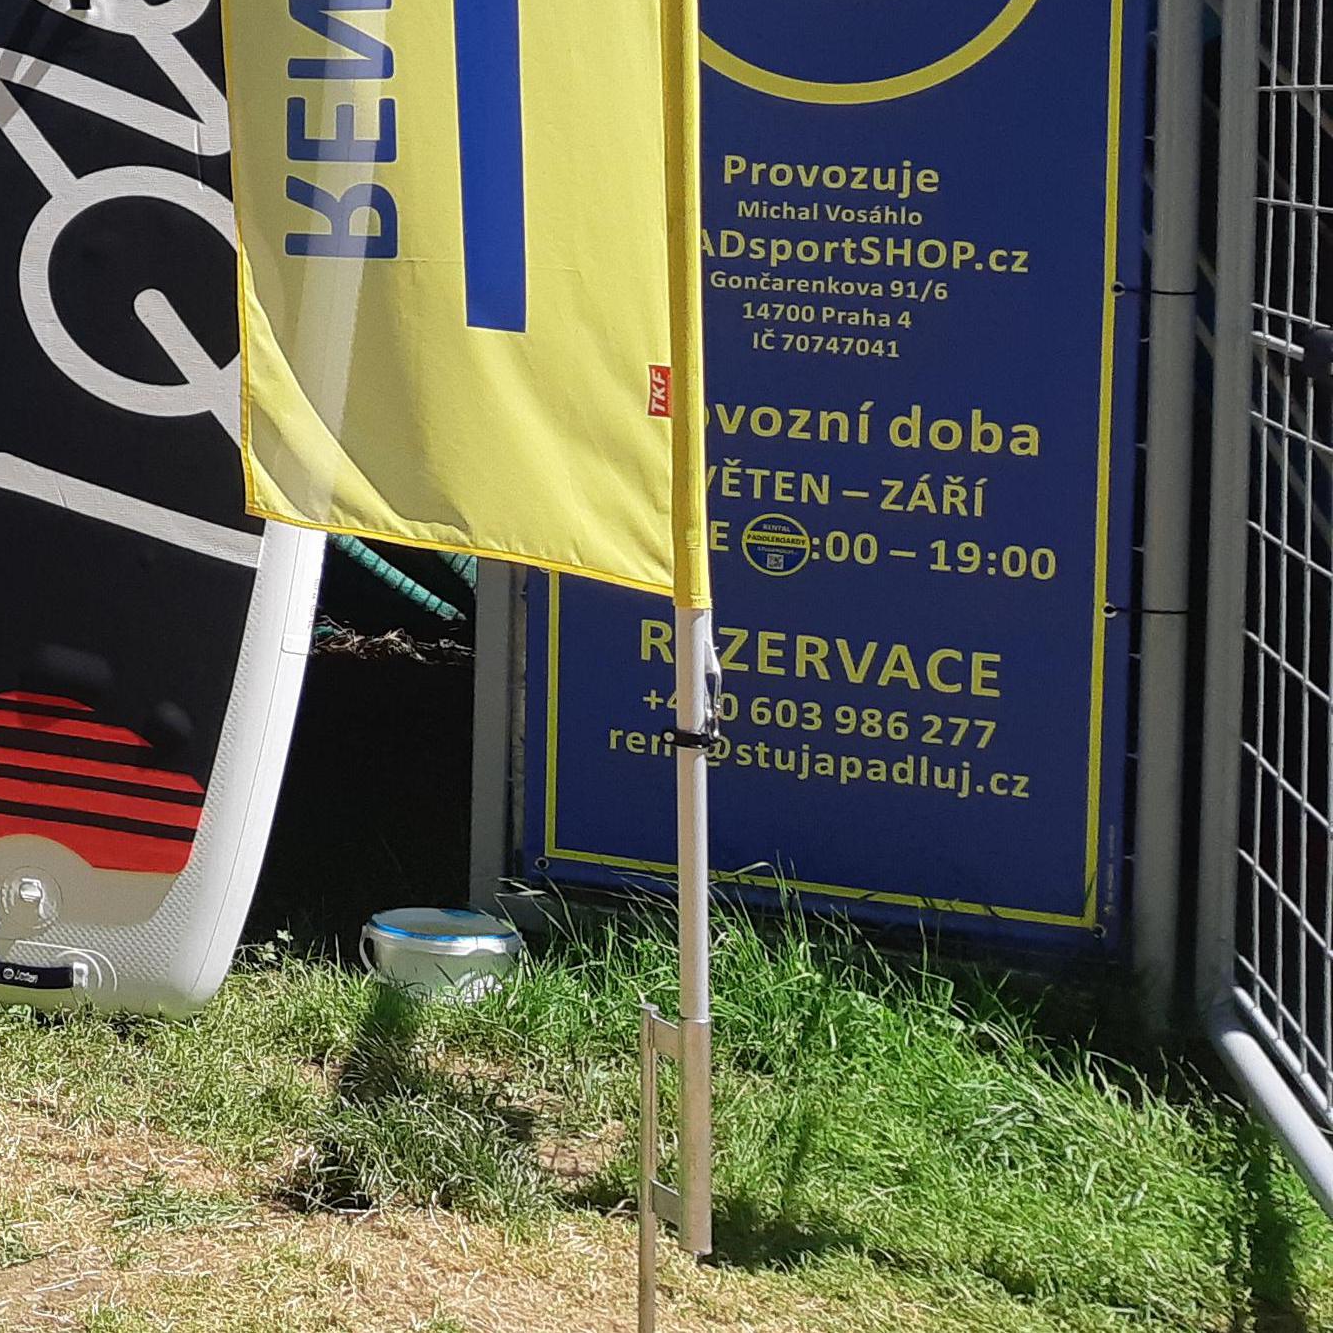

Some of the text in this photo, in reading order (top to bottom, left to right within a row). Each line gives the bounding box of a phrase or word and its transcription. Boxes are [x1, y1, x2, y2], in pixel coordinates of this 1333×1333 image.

[724, 154, 941, 199] Provozuje
[737, 200, 923, 226] Michal Vosáhlo
[710, 269, 949, 303] Gončarenkova 91/6
[742, 302, 913, 329] 14700 Praha 4
[752, 328, 900, 358] IČ 70747041
[651, 368, 666, 412] TKF
[705, 401, 1041, 457] vozní doba
[880, 473, 989, 517] ZÁŘÍ
[812, 531, 878, 564] :00
[929, 539, 1056, 580] 19:00
[640, 619, 1002, 698] RZERVACE
[642, 689, 997, 749] +40 603 986 277
[609, 725, 1031, 798] ren@stujapadluj.cz
